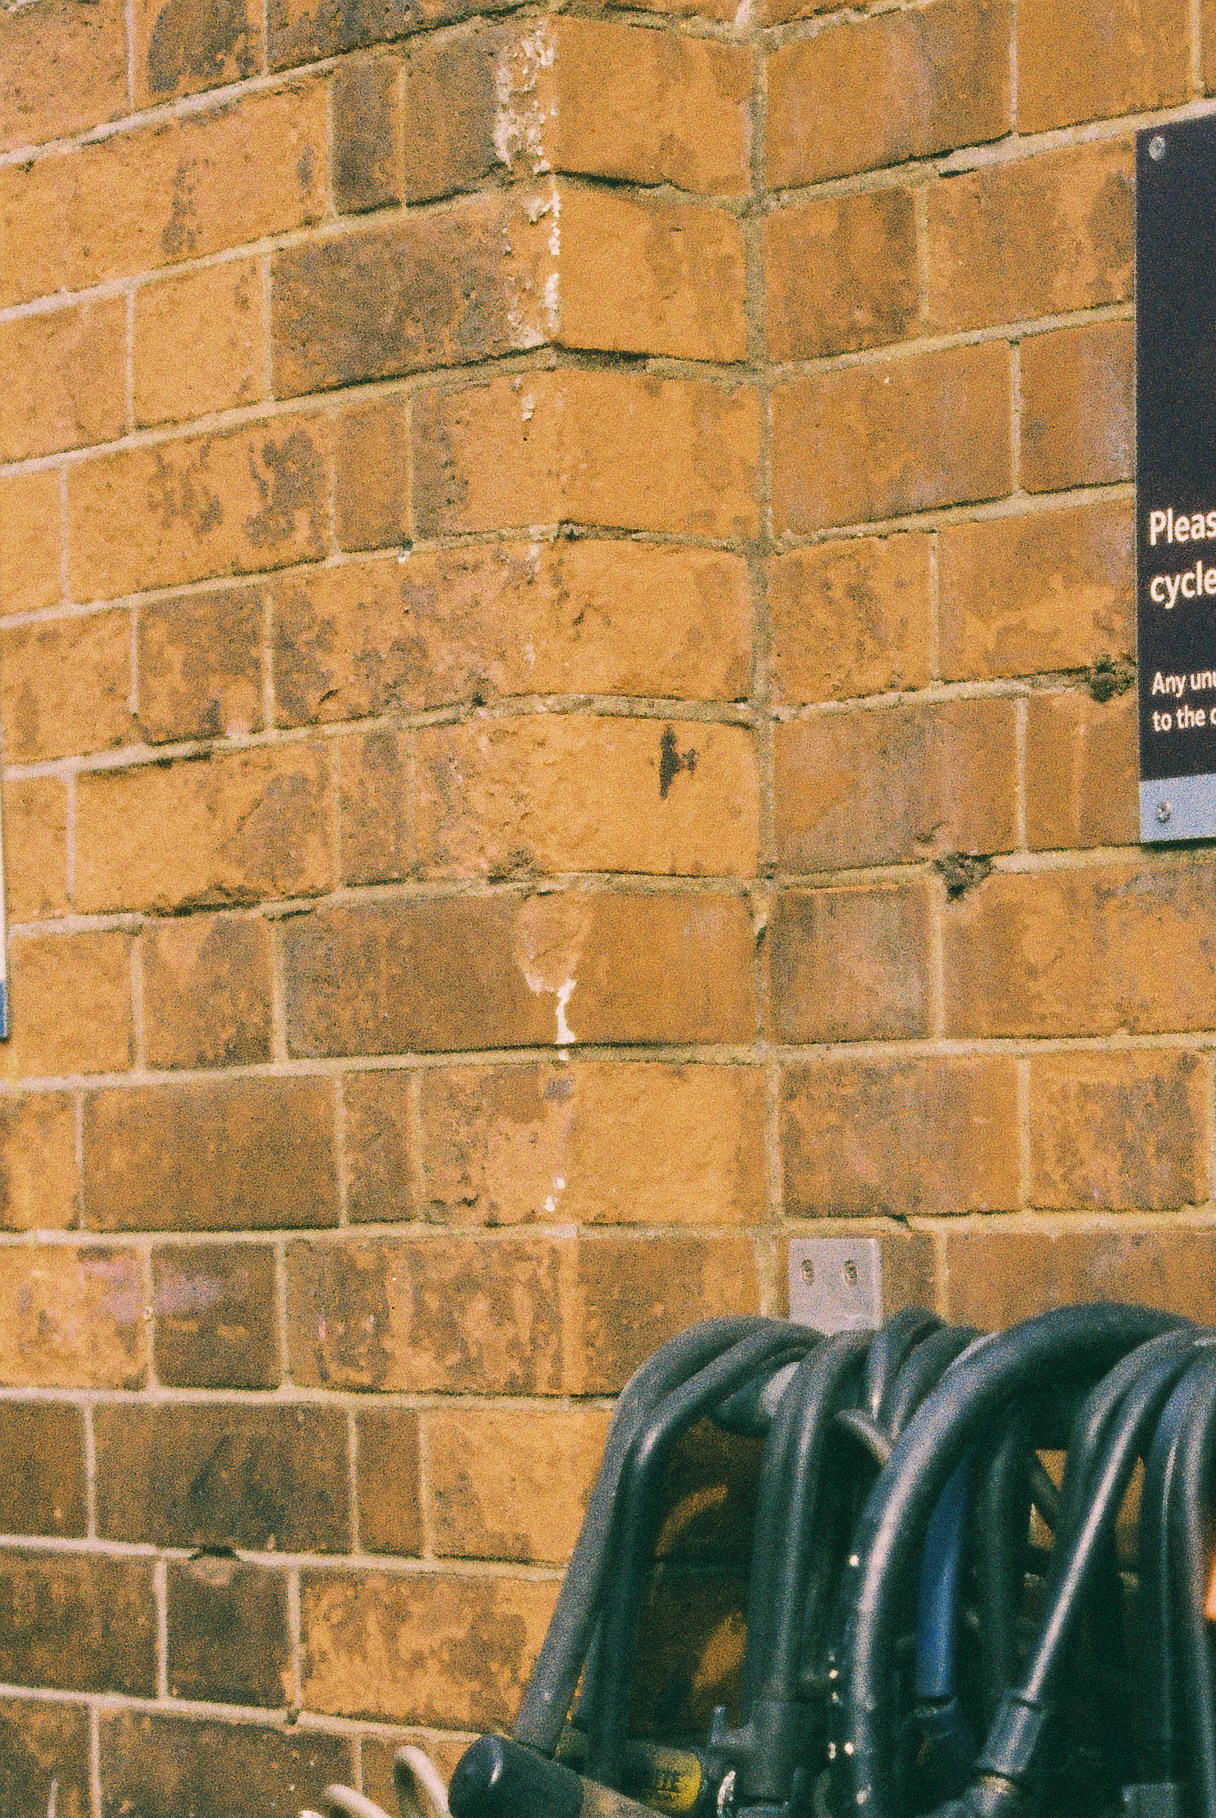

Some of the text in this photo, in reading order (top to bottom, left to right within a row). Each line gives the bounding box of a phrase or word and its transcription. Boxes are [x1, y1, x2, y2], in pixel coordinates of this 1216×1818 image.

[1151, 670, 1188, 699] Any
[1151, 709, 1173, 733] to
[1175, 704, 1207, 730] the
